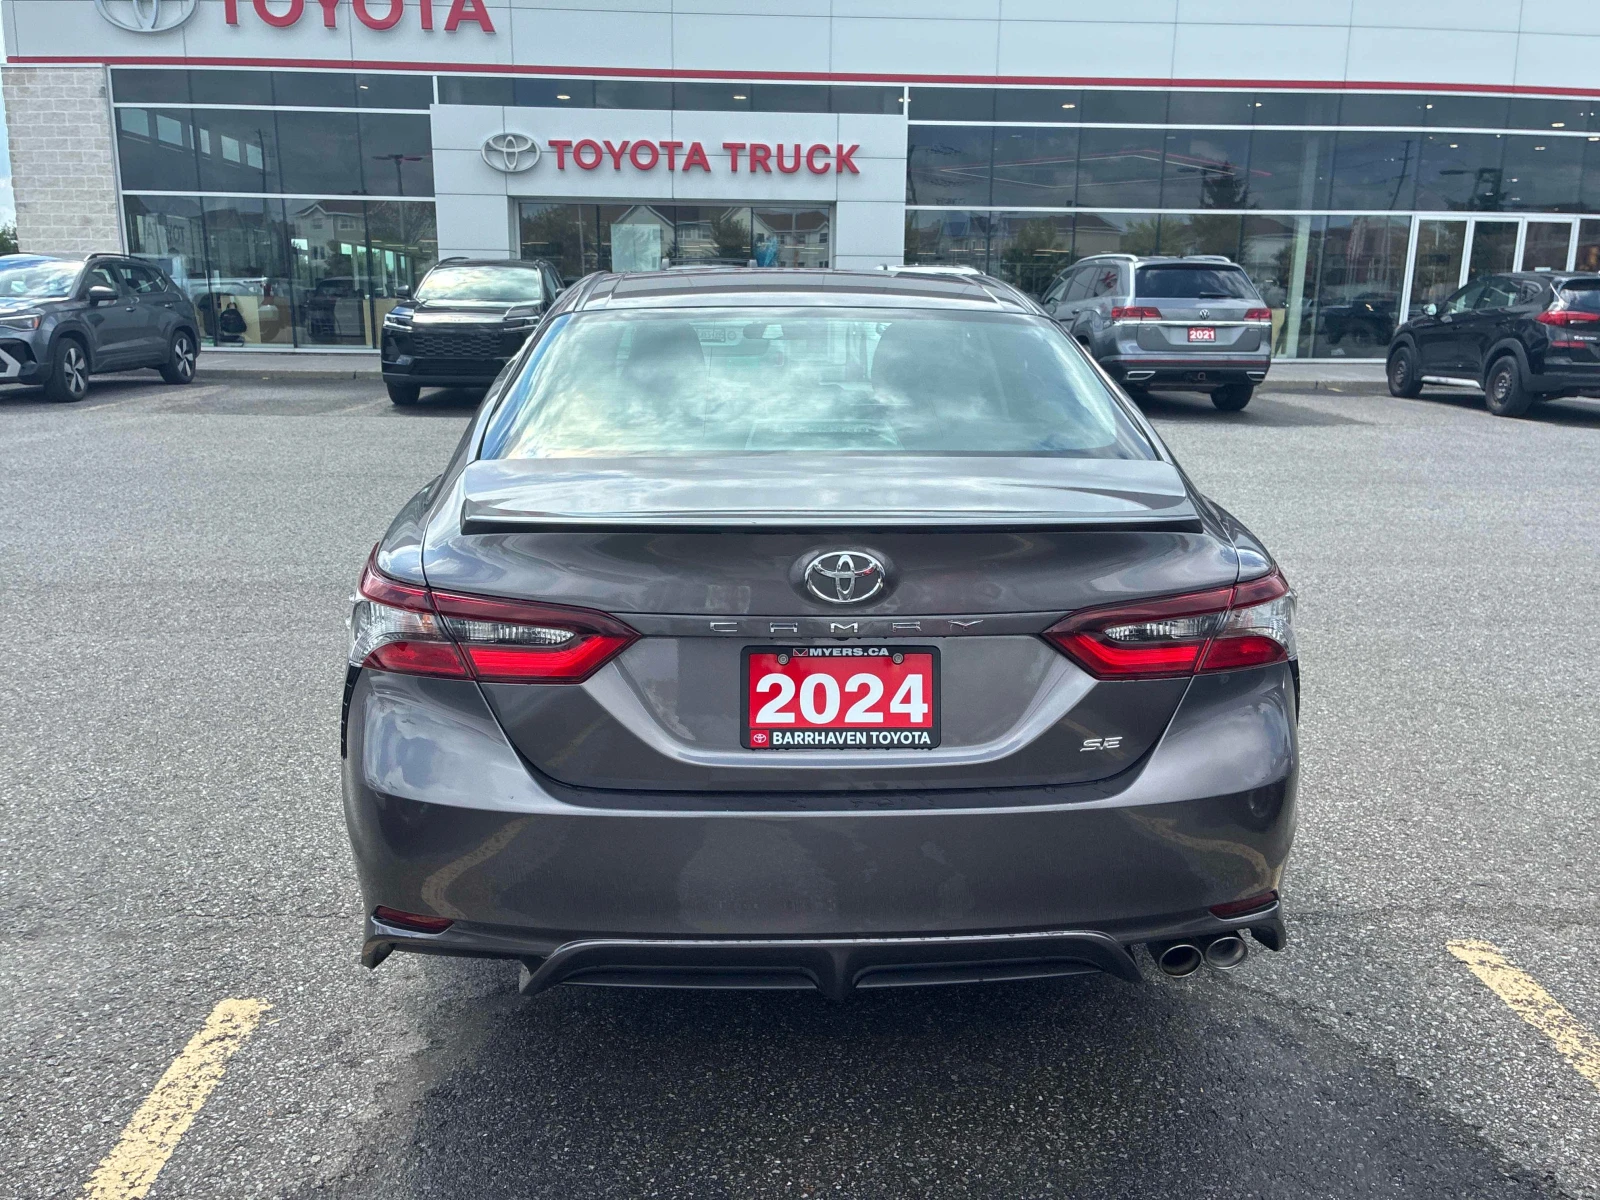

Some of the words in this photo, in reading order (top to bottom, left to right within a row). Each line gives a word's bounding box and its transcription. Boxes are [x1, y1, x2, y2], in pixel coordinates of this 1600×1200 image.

[547, 138, 712, 172] TOYOTA
[722, 142, 861, 175] TRUCK
[1189, 330, 1215, 339] 2021
[709, 619, 984, 633] CAMRY
[809, 647, 889, 657] MYERS.CA
[755, 672, 928, 725] 2024
[772, 731, 867, 745] BARRHAVEN
[870, 731, 931, 745] TOYOTA
[1079, 736, 1123, 752] SE
